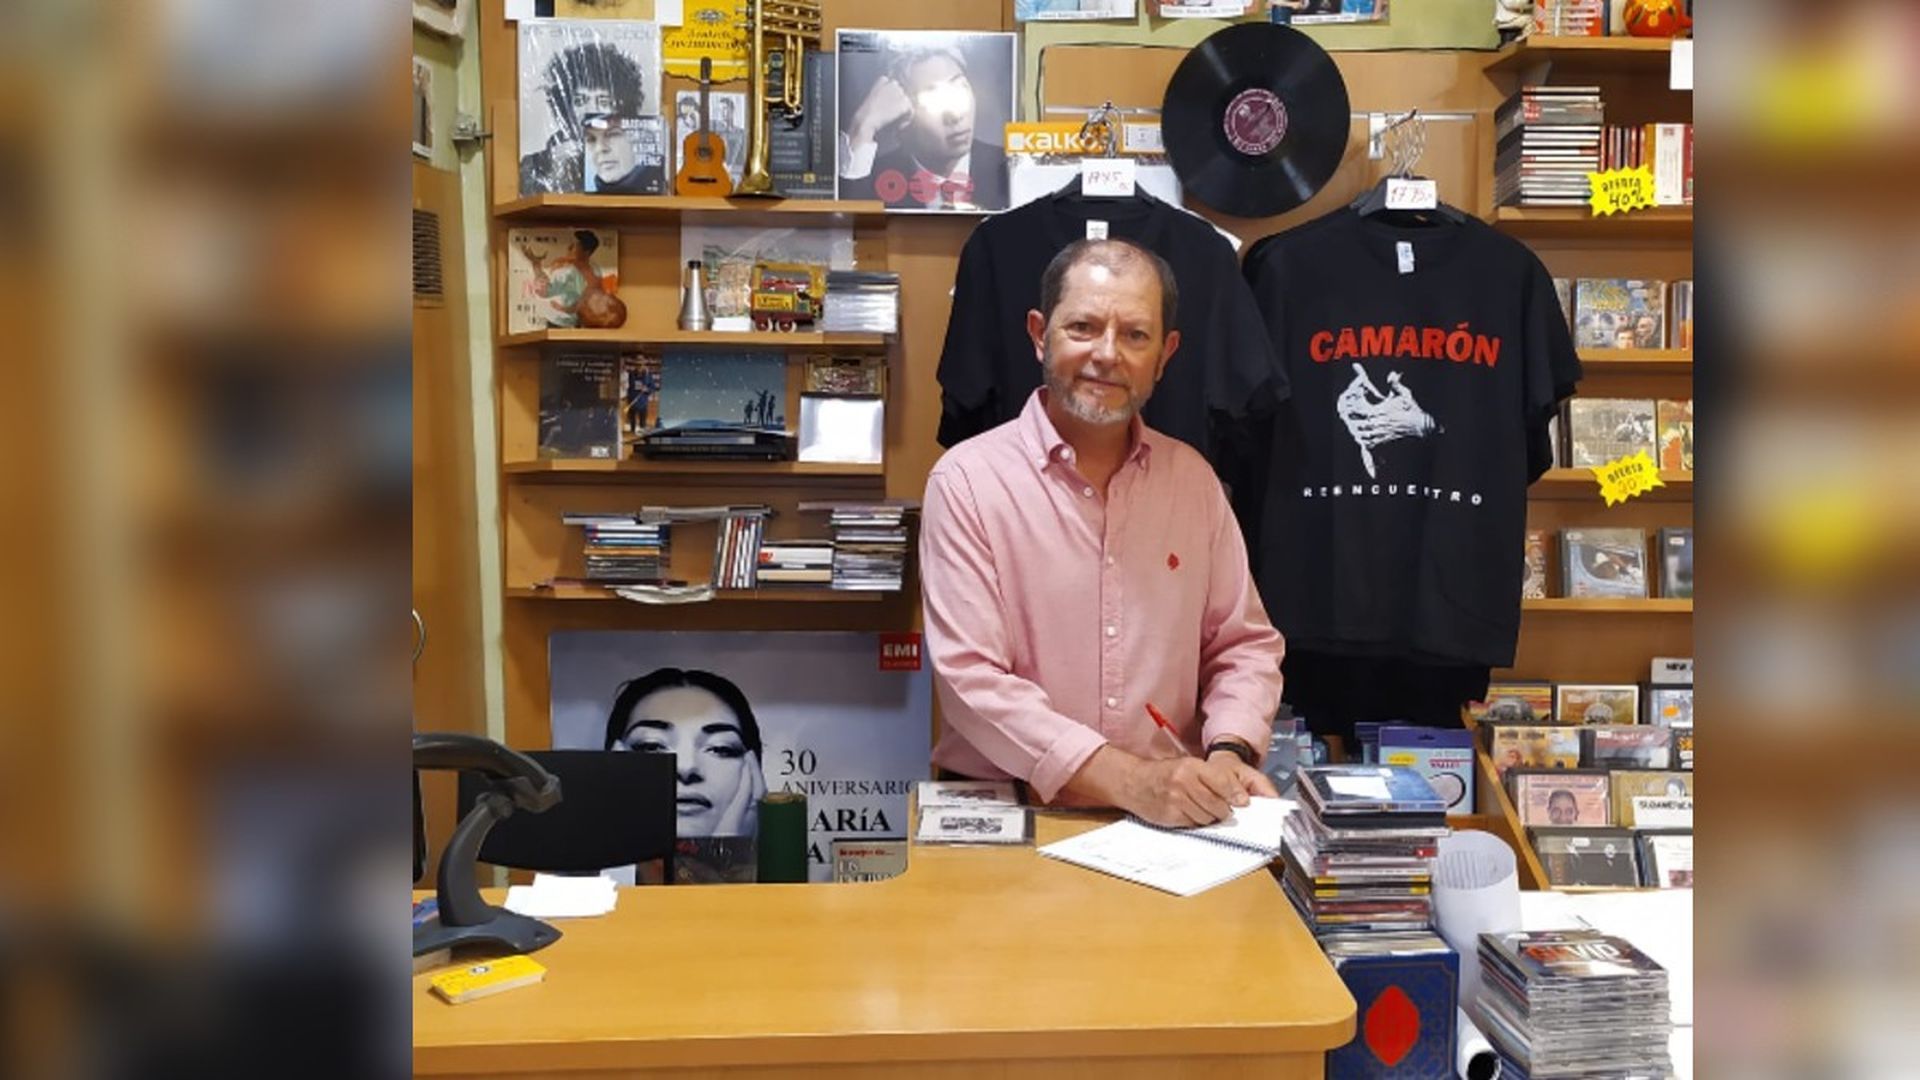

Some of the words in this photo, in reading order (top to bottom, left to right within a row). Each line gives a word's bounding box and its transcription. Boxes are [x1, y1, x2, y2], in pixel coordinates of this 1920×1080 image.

[1310, 321, 1501, 367] CAMARÓN
[883, 643, 918, 657] EMI
[781, 748, 817, 776] 30
